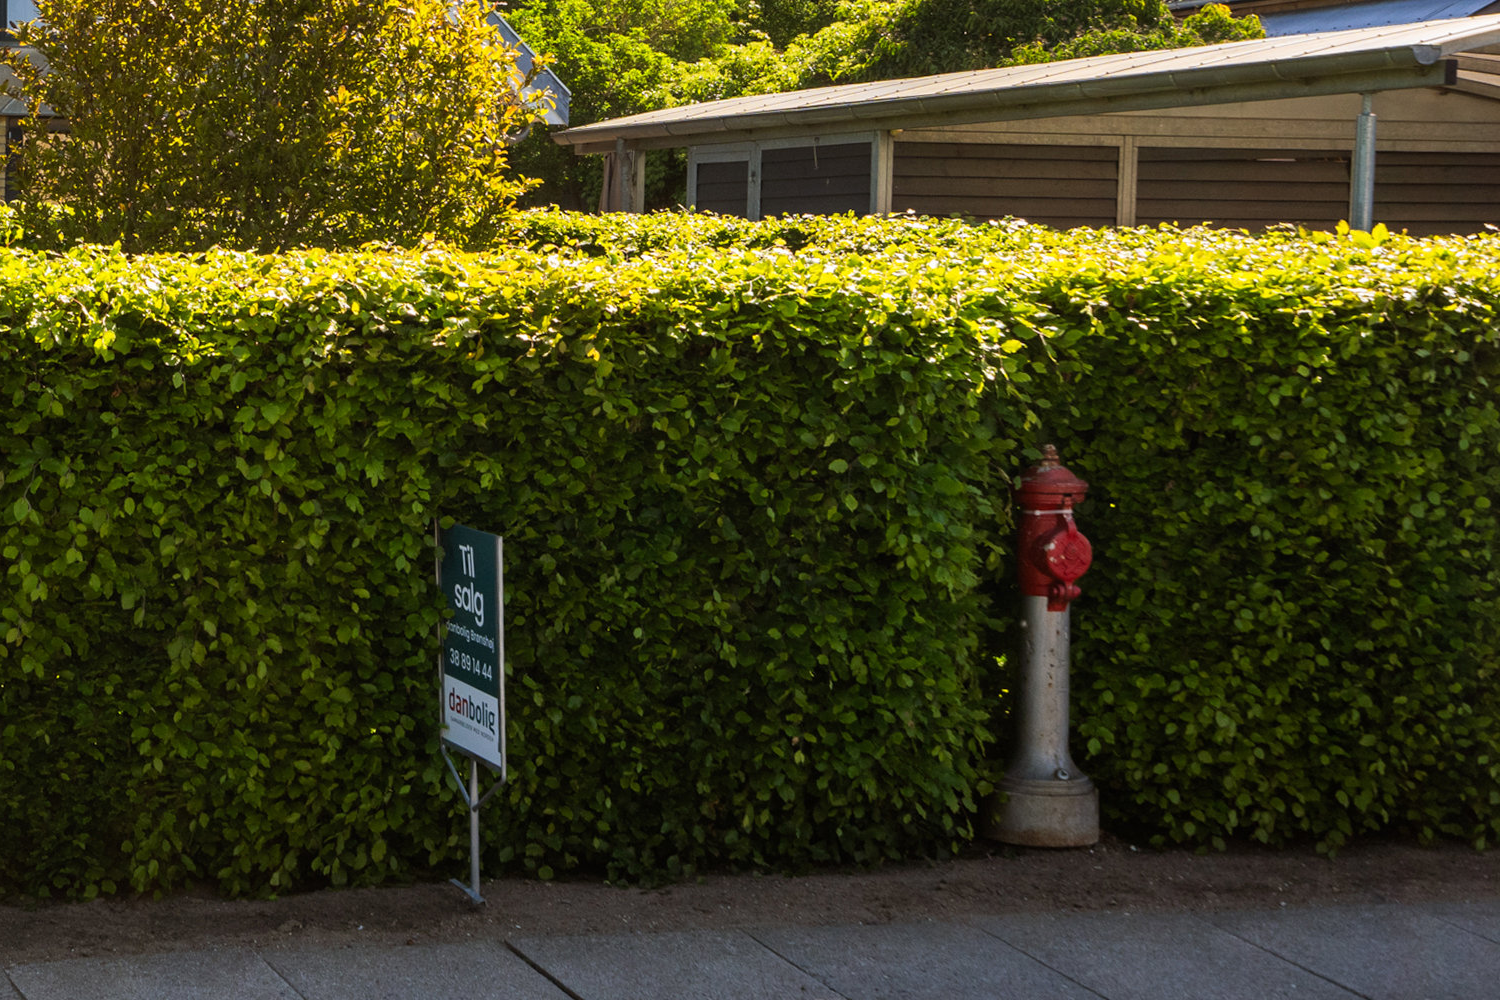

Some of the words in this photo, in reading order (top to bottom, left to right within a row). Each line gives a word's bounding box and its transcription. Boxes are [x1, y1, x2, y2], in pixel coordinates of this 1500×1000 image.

[458, 544, 476, 578] Til
[454, 581, 485, 627] salg
[446, 619, 471, 643] danbolig
[450, 647, 460, 667] 38
[460, 652, 471, 672] 89
[471, 656, 481, 677] 14
[481, 662, 493, 682] 44
[448, 687, 496, 736] danbolig
